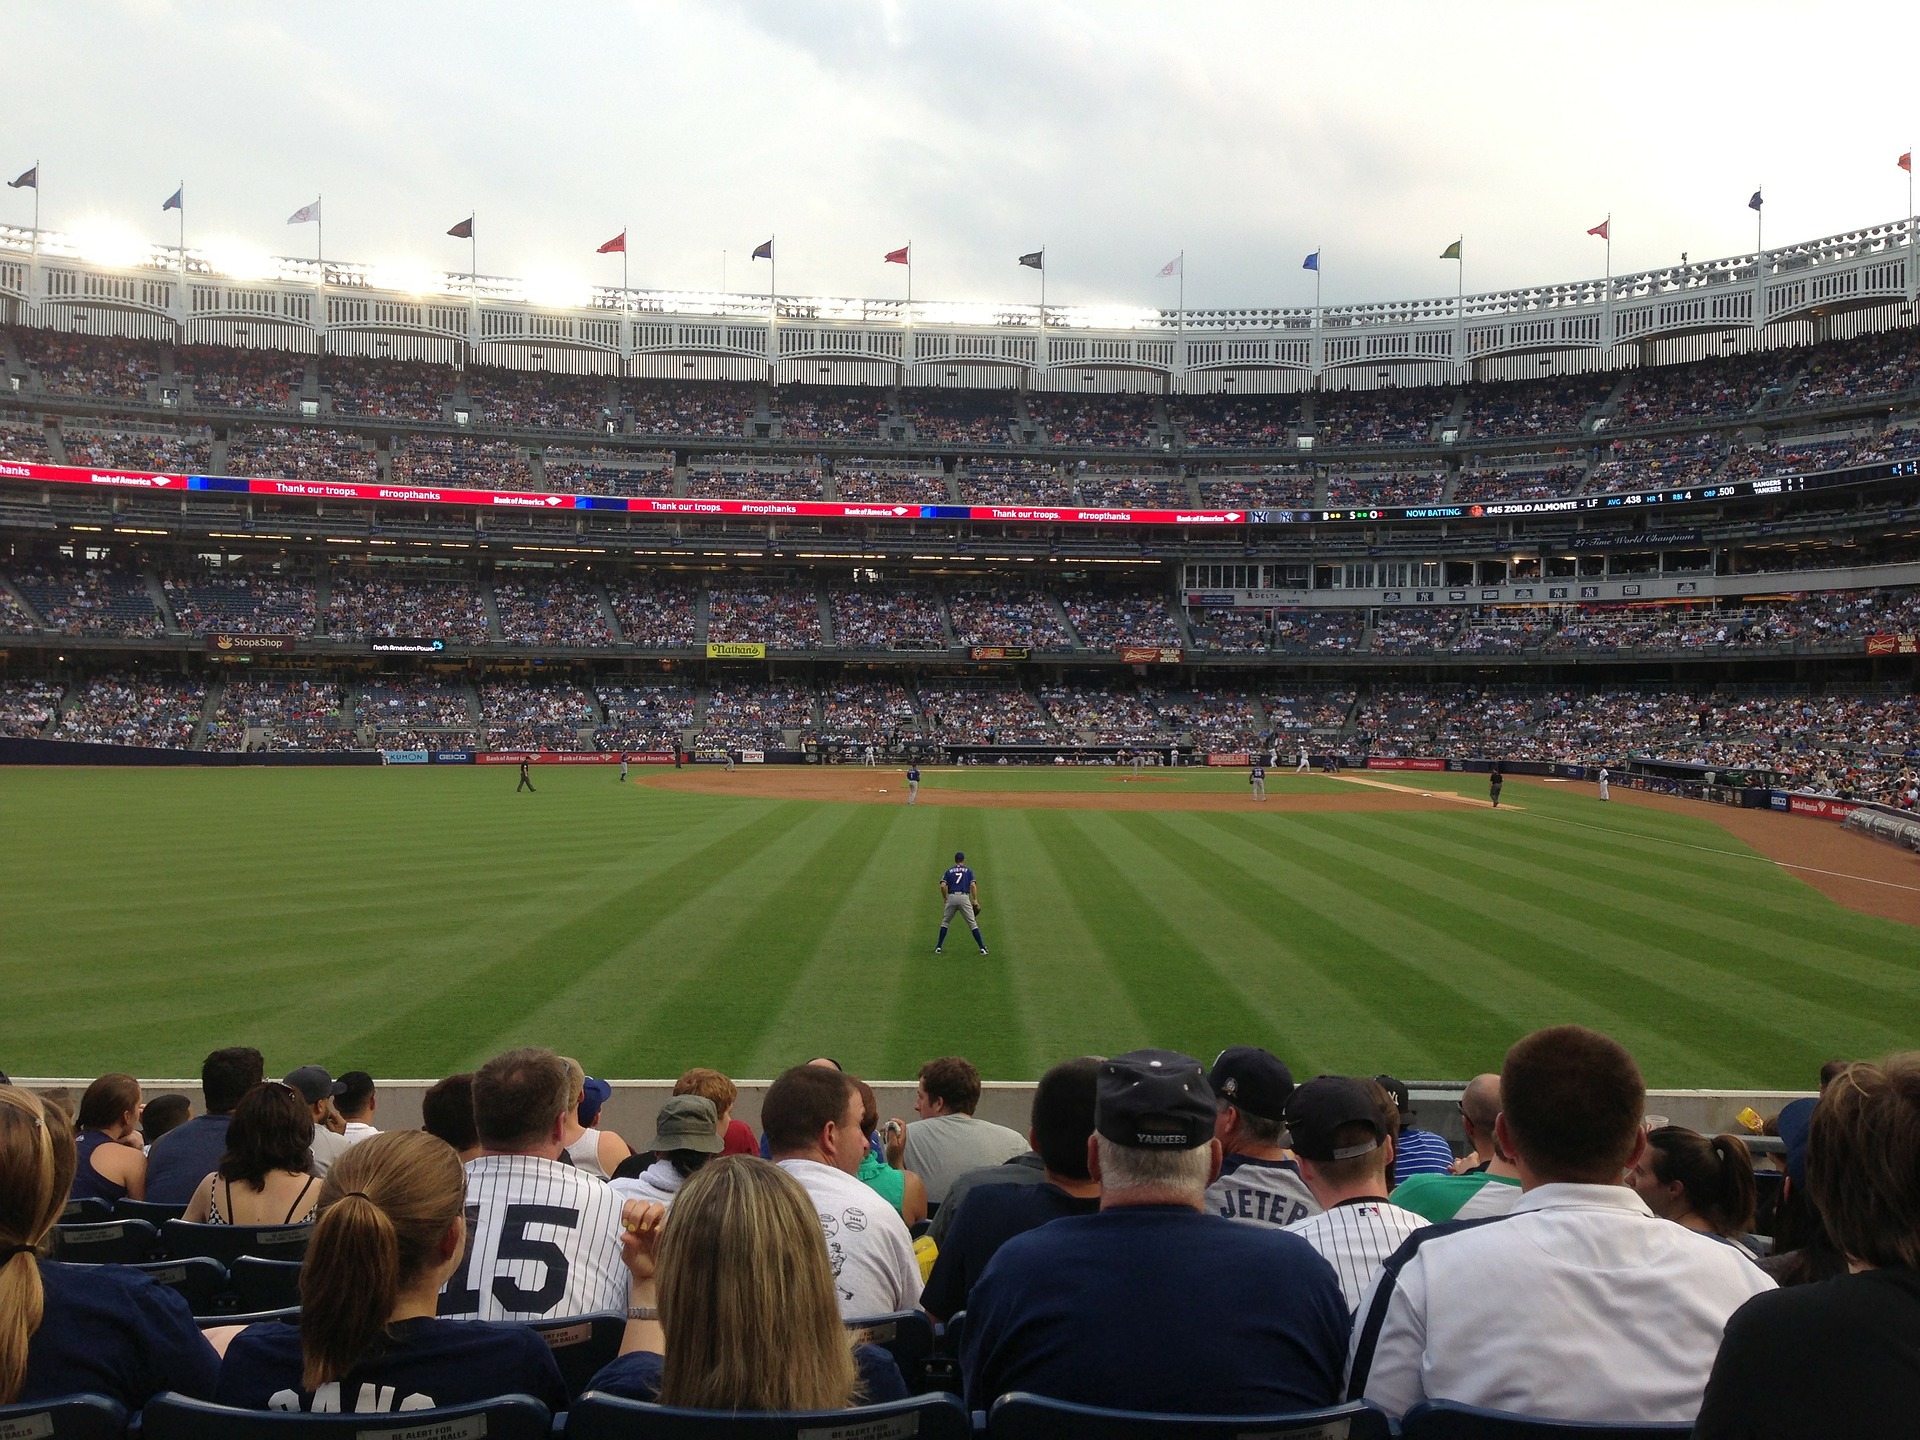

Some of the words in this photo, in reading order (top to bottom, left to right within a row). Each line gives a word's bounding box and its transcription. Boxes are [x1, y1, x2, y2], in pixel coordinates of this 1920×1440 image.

[1752, 479, 1782, 488] RANGERS
[276, 483, 305, 493] Thank
[307, 486, 324, 494] our
[325, 486, 358, 497] troops.
[380, 489, 441, 500] #troopthanks
[1754, 486, 1782, 494] YANKEES
[1624, 496, 1642, 505] .438
[1658, 494, 1663, 502] 1
[1684, 492, 1692, 500] 4
[1718, 486, 1734, 496] .500
[652, 501, 676, 510] Thank
[678, 503, 692, 511] our
[694, 502, 723, 513] troops.
[742, 504, 796, 514] #troopthanks
[1486, 506, 1503, 514] #45
[1504, 504, 1532, 513] ZOILO
[1533, 501, 1578, 512] ALMONTE
[1587, 500, 1598, 508] LF
[992, 510, 1016, 518] Thank
[1033, 510, 1061, 520] troops.
[1078, 512, 1130, 521] #troopthanks
[1322, 512, 1330, 521] B
[1350, 511, 1356, 520] S
[1406, 510, 1426, 518] NOW
[1574, 538, 1612, 548] 27-Time
[1614, 534, 1642, 544] World
[1646, 533, 1694, 544] Champions
[234, 638, 282, 649] Stop&Shop
[712, 644, 759, 654] Nathan's
[1771, 797, 1786, 806] GEICO
[955, 873, 962, 884] 7
[1137, 1134, 1187, 1144] YANKEES
[406, 1430, 432, 1439] ALERT
[435, 1426, 452, 1434] FOR
[846, 1429, 869, 1437] ALERT
